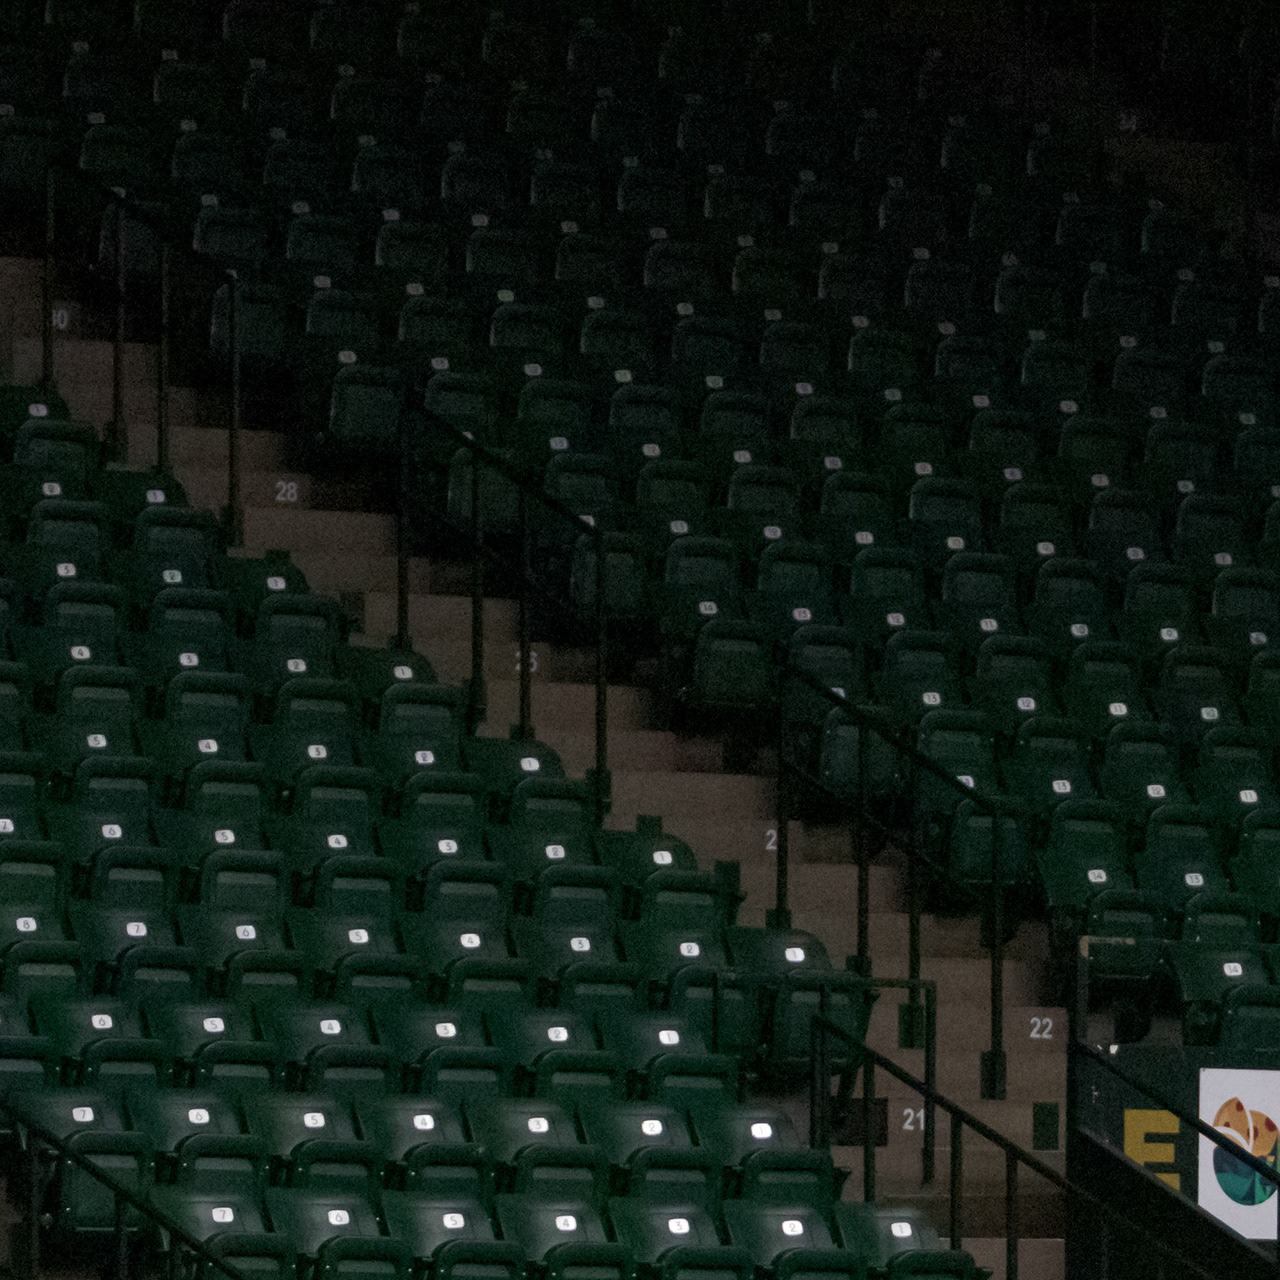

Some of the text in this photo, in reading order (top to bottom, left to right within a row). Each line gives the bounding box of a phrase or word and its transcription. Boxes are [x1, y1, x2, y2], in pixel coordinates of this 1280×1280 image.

[275, 481, 298, 501] 28
[1030, 1017, 1053, 1039] 22
[902, 1108, 925, 1130] 21
